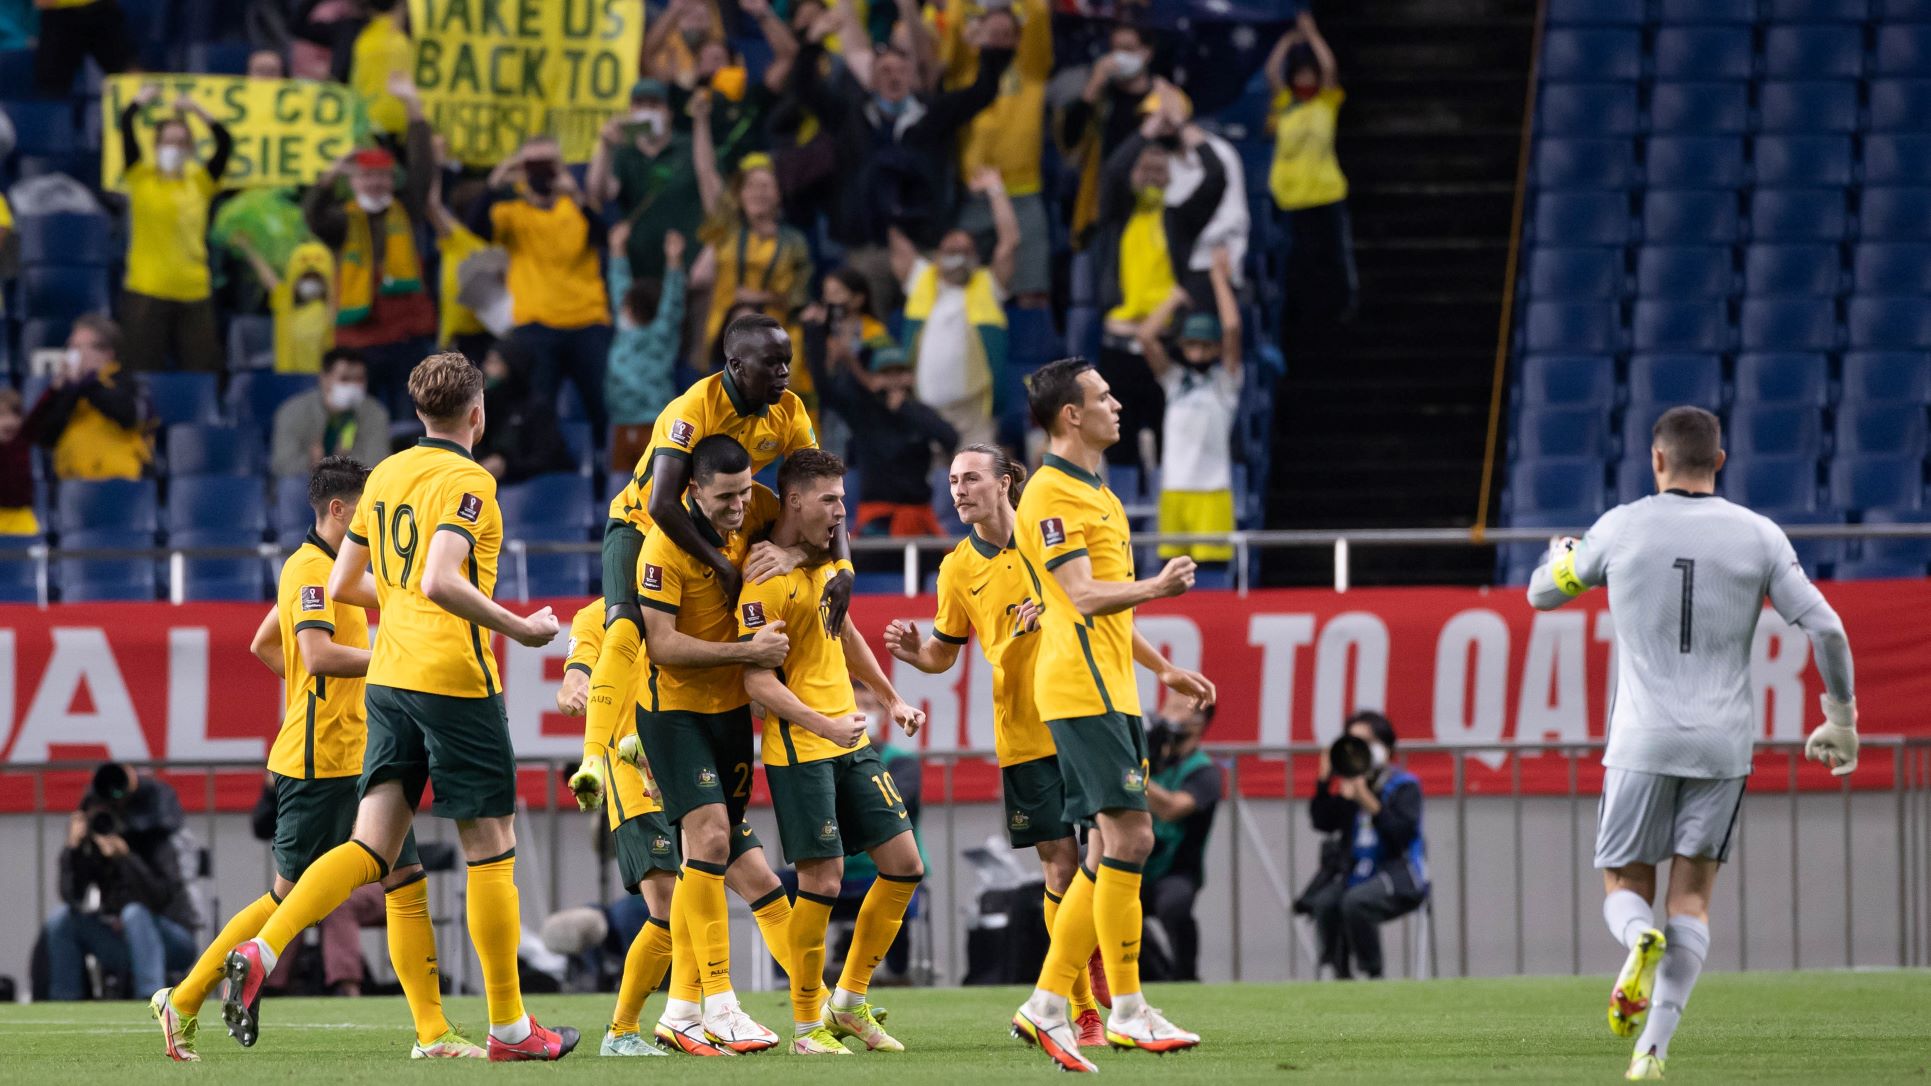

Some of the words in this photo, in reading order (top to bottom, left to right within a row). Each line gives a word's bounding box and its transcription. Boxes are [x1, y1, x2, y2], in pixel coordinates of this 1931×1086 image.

[563, 0, 624, 39] US
[415, 39, 546, 97] BACK
[564, 51, 621, 98] TO
[276, 87, 344, 126] GO
[373, 501, 418, 589] 19
[1672, 558, 1695, 653] 1
[591, 696, 614, 706] AUS
[1248, 609, 1390, 761] TO
[871, 771, 903, 807] 10
